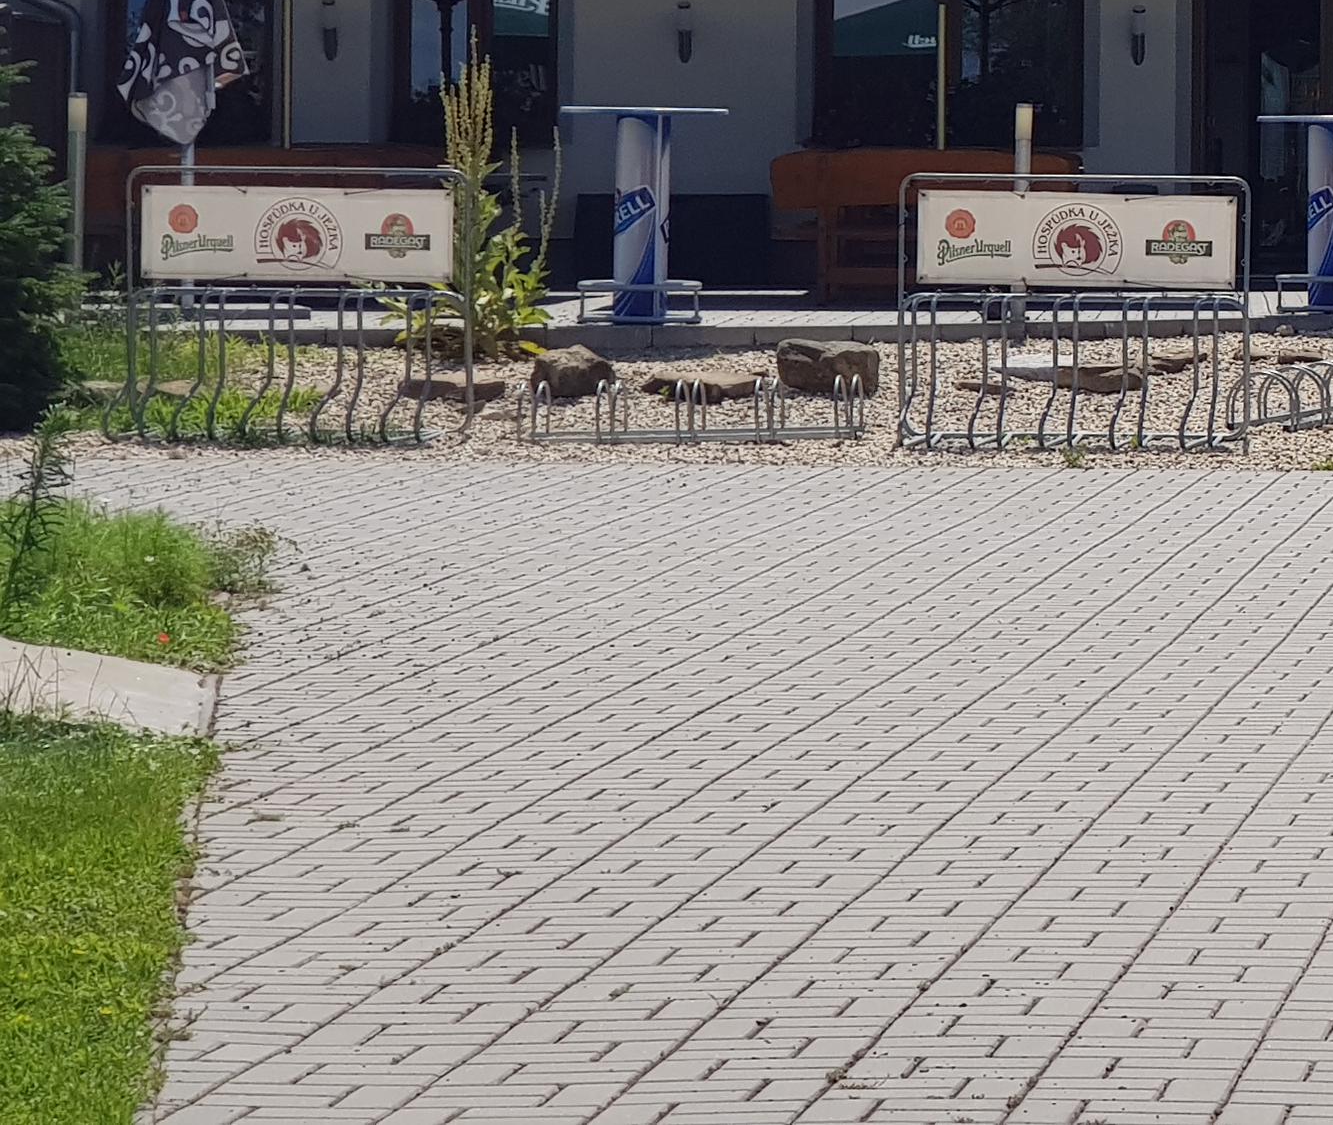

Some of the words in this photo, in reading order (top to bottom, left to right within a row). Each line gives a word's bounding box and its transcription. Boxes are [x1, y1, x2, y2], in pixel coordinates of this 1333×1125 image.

[309, 204, 320, 215] U
[1089, 210, 1099, 221] U
[370, 236, 427, 249] RADEGAST
[1151, 242, 1209, 256] RADEGAST
[937, 239, 976, 266] Pilsner
[974, 238, 1012, 259] Urquell
